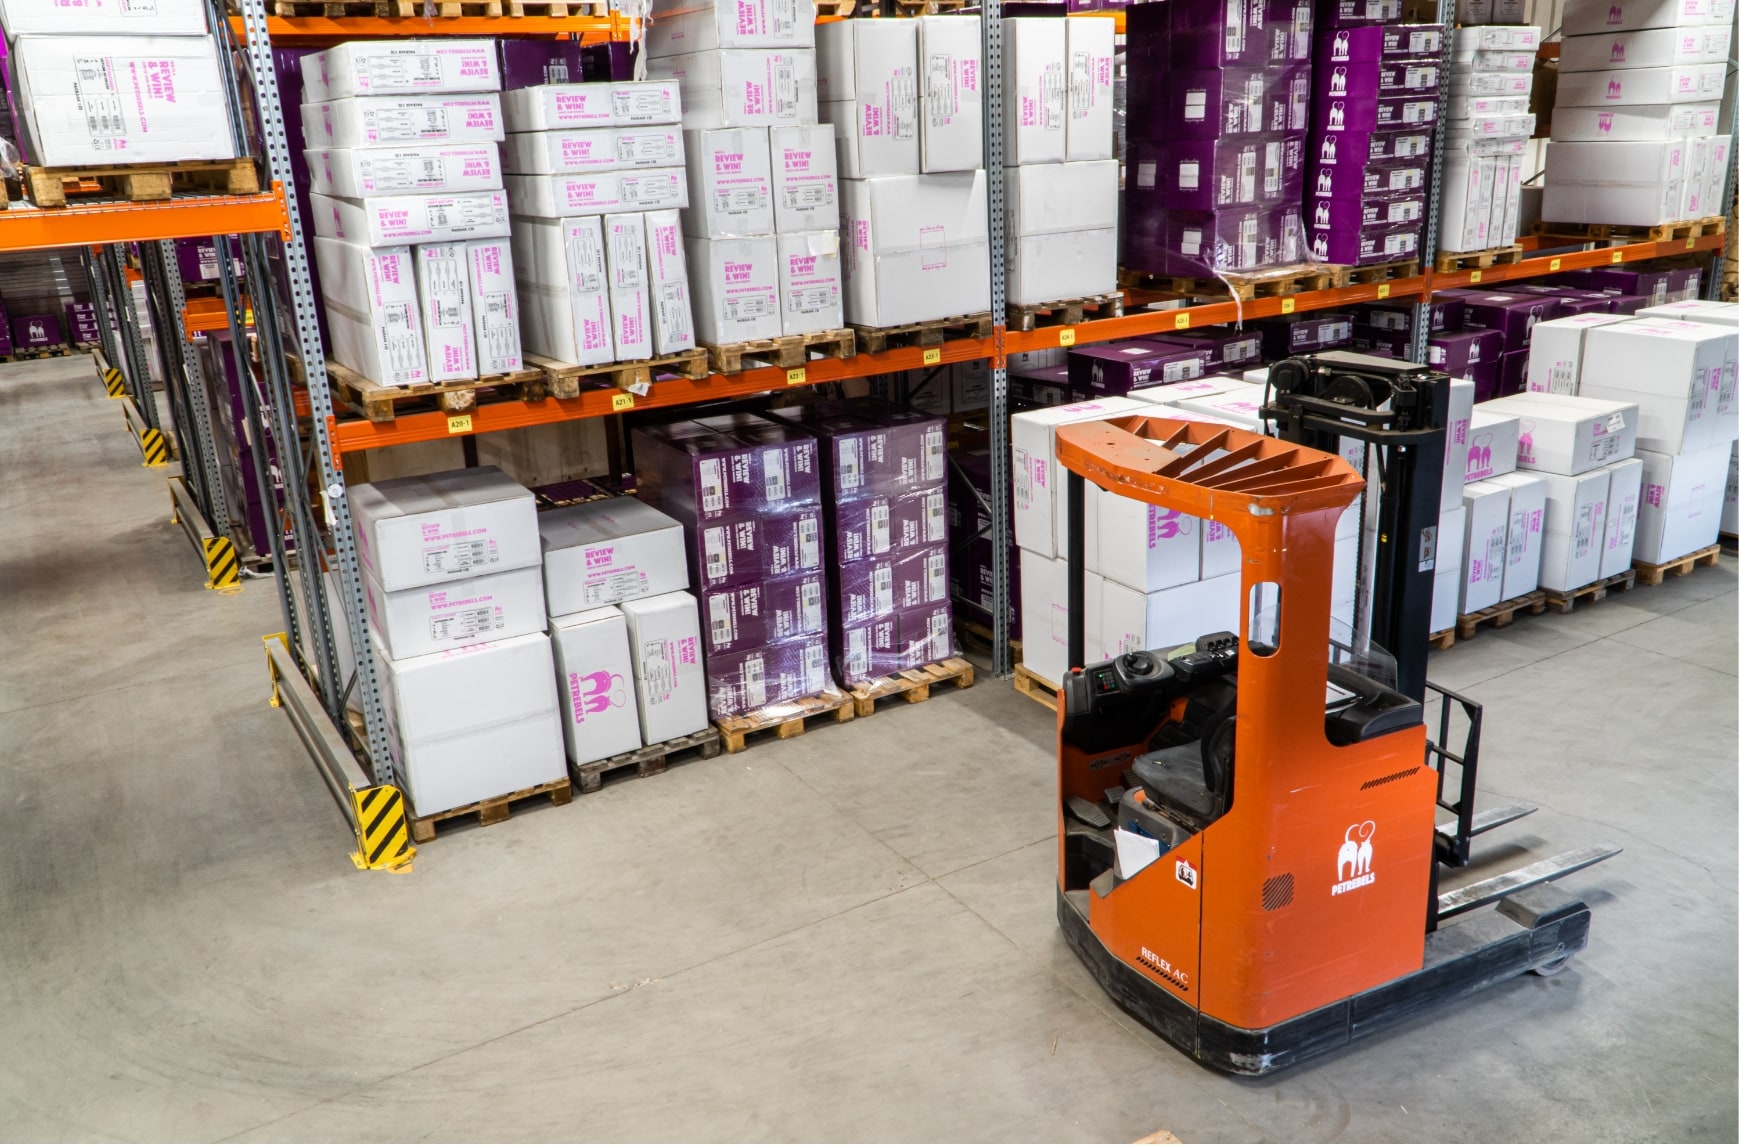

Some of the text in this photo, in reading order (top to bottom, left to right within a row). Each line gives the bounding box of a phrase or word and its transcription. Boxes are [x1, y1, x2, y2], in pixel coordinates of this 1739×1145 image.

[149, 61, 164, 98] & WIN!
[159, 61, 176, 103] REVIEW
[460, 68, 488, 76] REVIEW
[466, 120, 494, 129] REVIEW
[715, 154, 743, 162] REVIEW
[379, 211, 408, 220] REVIEW
[669, 226, 677, 256] REVIEW
[389, 256, 400, 284] REVIEW
[491, 247, 500, 274] REVIEW
[725, 264, 752, 272] REVIEW
[790, 257, 816, 265] REVIEW
[383, 264, 391, 282] WIN!
[444, 345, 452, 372] REVIEW
[926, 352, 938, 361] A23-1
[790, 372, 804, 382] A22-1
[616, 398, 632, 406] A21-1
[741, 454, 750, 483] REVIEW
[746, 521, 754, 550] REVIEW
[585, 547, 614, 559] REVIEW
[595, 557, 612, 565] WIN!
[688, 637, 696, 665] REVIEW
[569, 673, 584, 724] PETREBELS
[1332, 872, 1375, 896] PETREBELS
[1141, 946, 1188, 983] REFLEX AC
